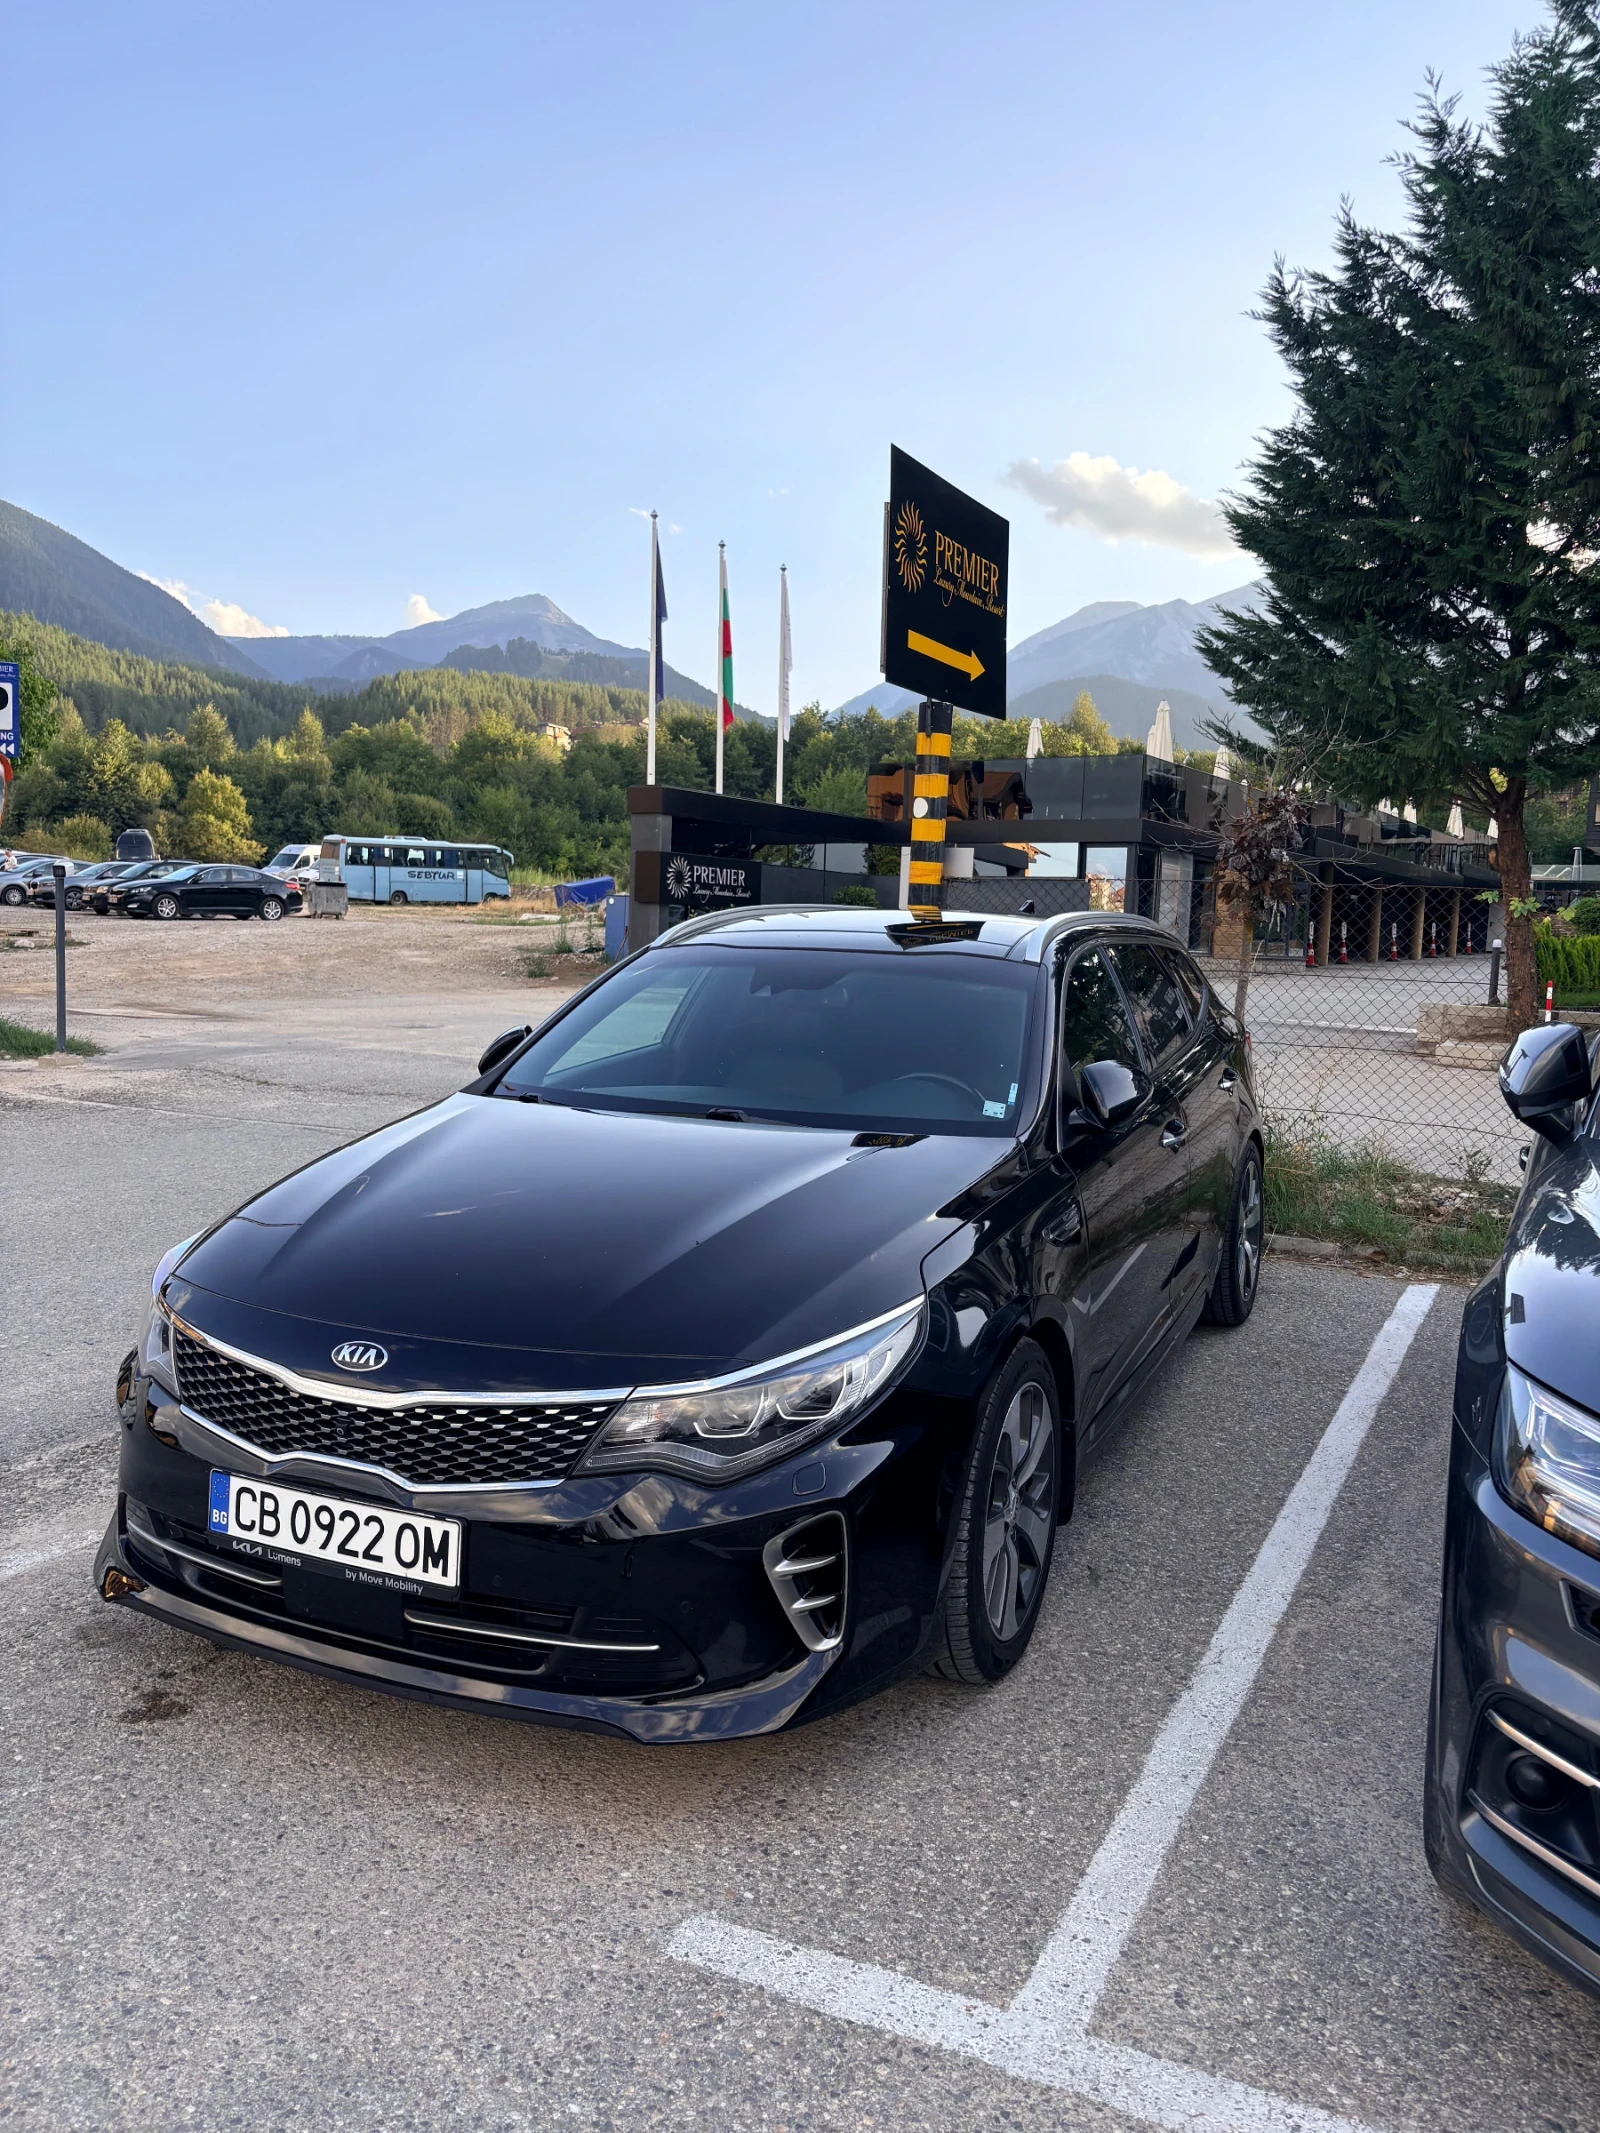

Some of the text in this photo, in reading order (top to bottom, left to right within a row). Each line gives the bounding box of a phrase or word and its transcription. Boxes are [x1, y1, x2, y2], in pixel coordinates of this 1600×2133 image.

[935, 530, 998, 596] PREMIER
[933, 565, 1006, 617] Luxury Mountain Resort
[693, 865, 745, 886] PREMIER
[338, 1344, 376, 1365] KIA
[212, 1509, 228, 1525] BG
[235, 1486, 450, 1578] CB 0922 OM
[232, 1540, 302, 1567] KIA Lumens
[345, 1568, 424, 1595] by Move Mobility
